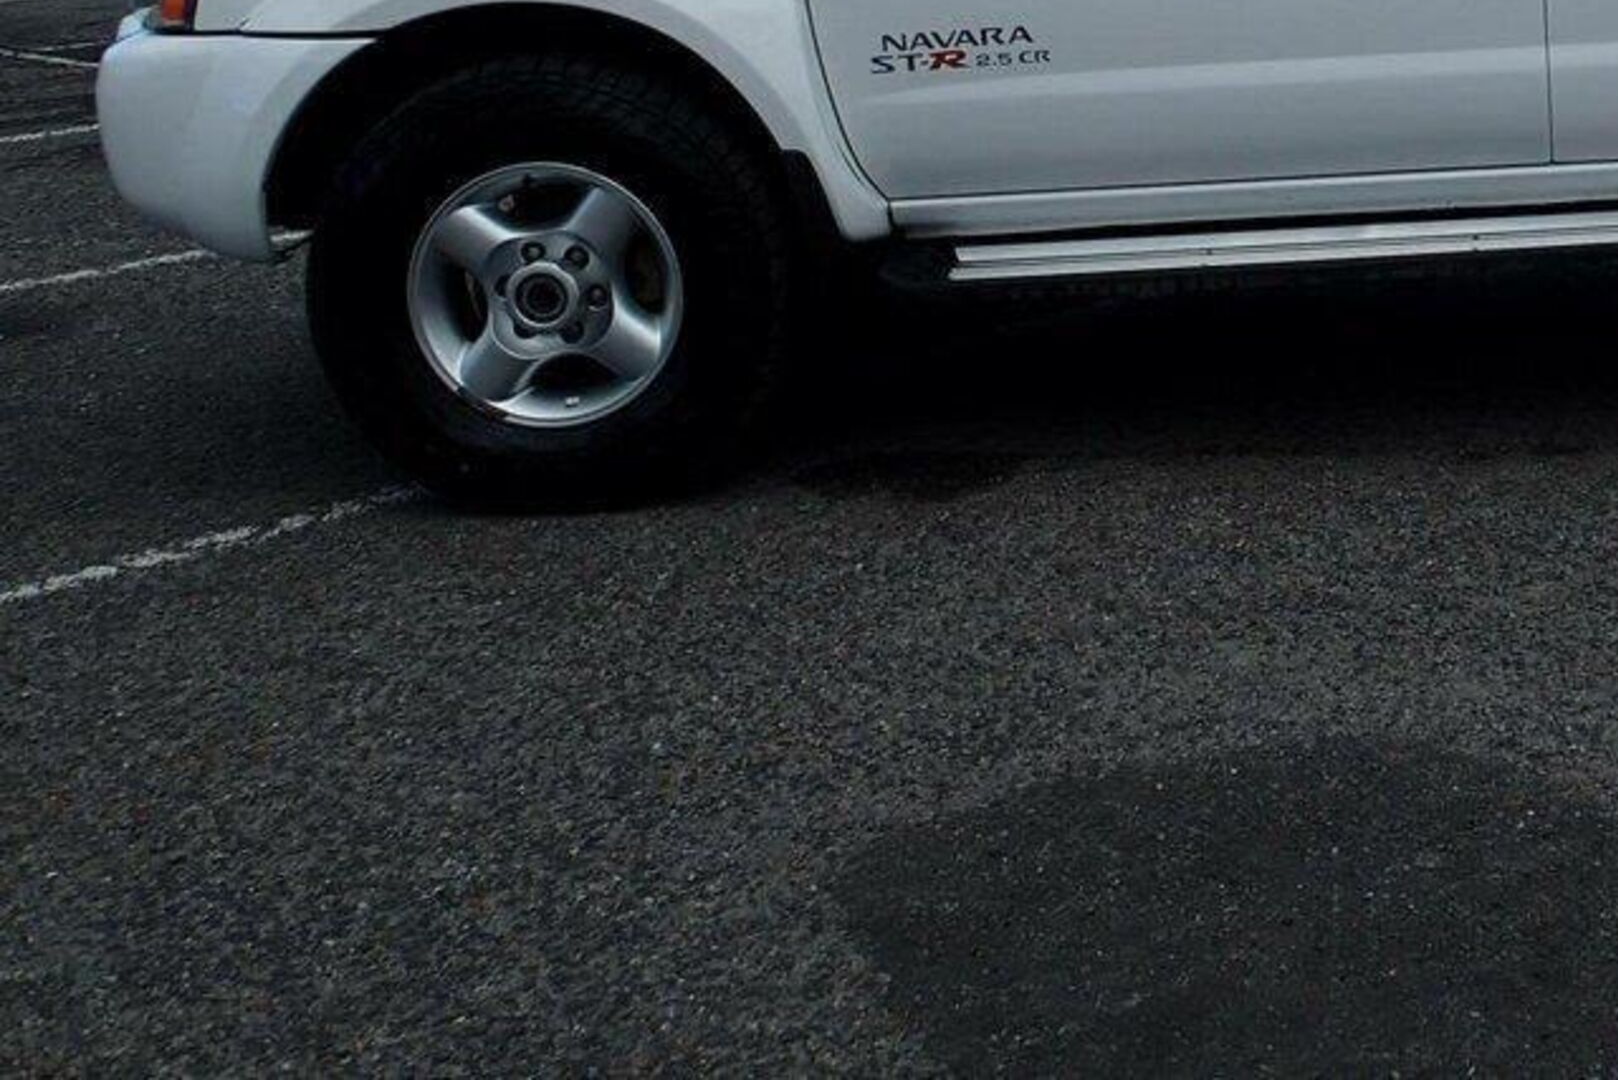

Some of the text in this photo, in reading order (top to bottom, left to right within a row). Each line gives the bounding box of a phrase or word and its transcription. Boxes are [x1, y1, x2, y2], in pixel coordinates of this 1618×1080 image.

[881, 25, 1035, 52] NAVARA
[870, 49, 1051, 74] ST-R 2.5 CR
